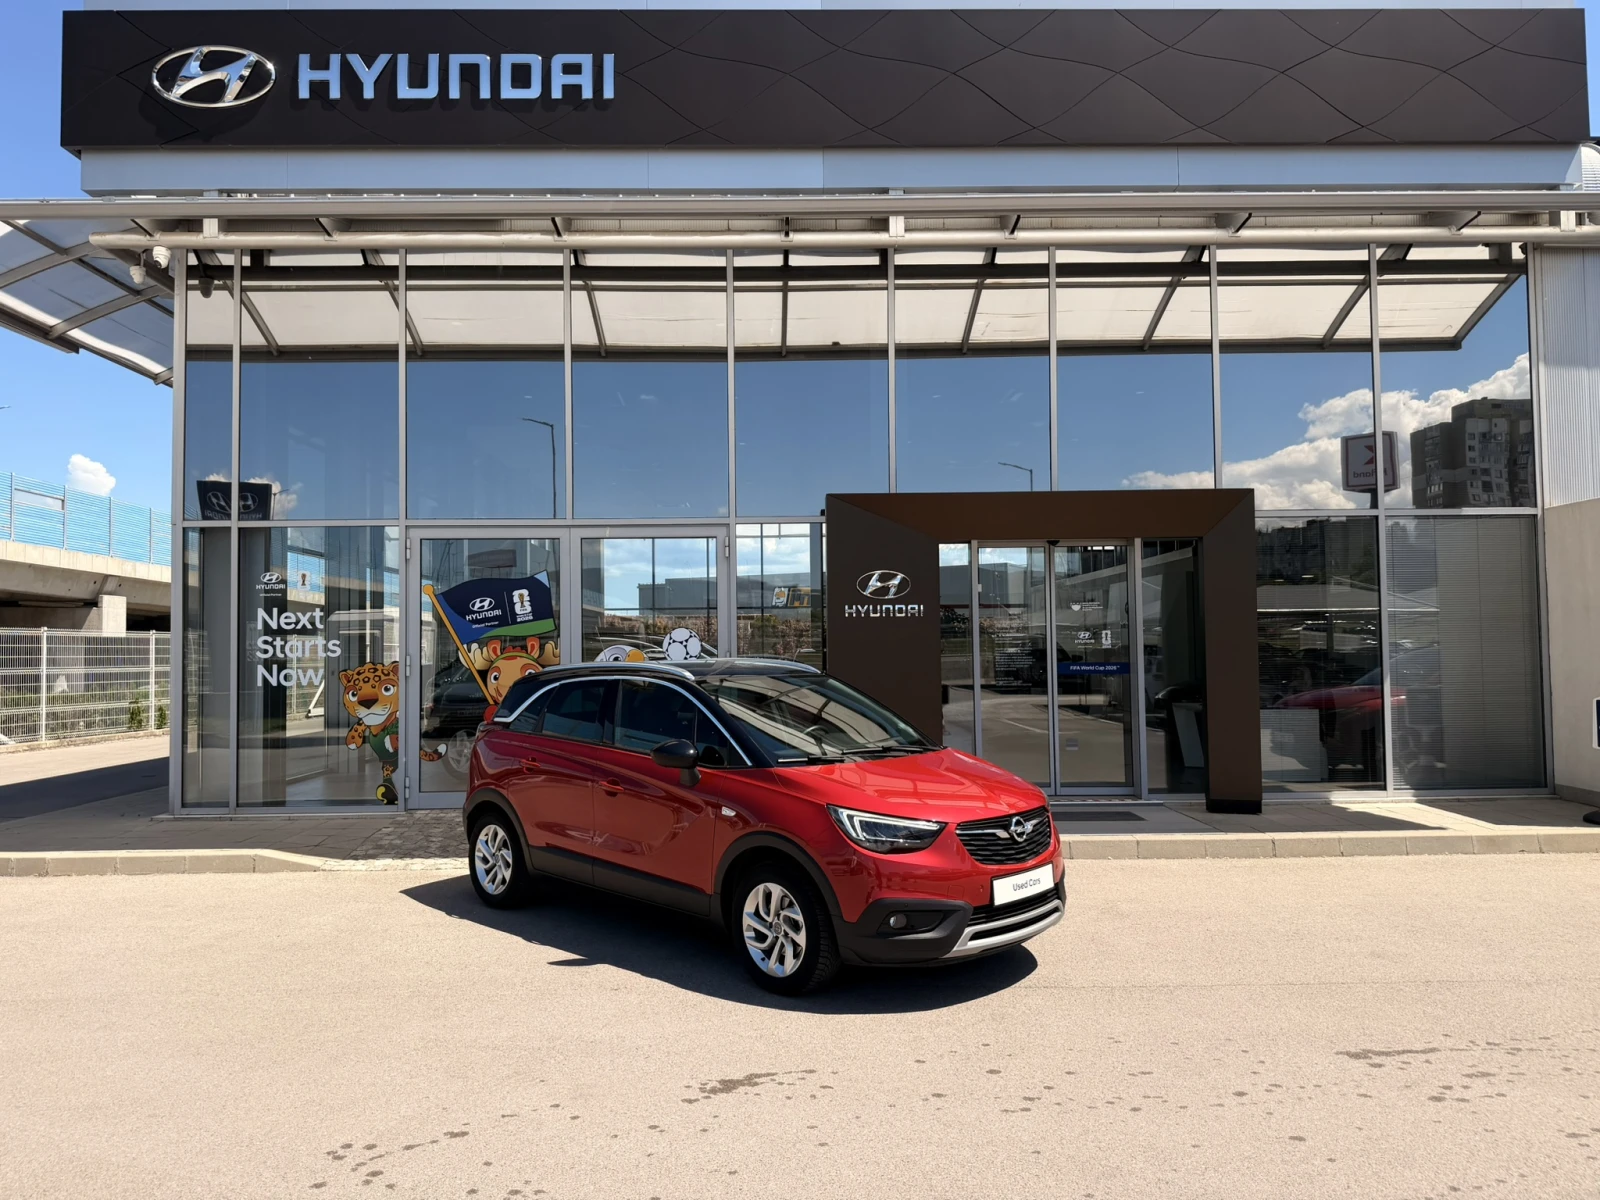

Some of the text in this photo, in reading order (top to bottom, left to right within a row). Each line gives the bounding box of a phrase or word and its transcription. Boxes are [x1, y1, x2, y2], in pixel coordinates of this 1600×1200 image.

[298, 53, 615, 99] HYUNDAI
[257, 607, 324, 630] Next
[465, 609, 502, 621] HYUNDAI
[844, 604, 924, 617] HYUNDAI
[256, 636, 342, 659] Starts
[257, 664, 324, 687] Now
[1012, 878, 1041, 891] Used Cars
